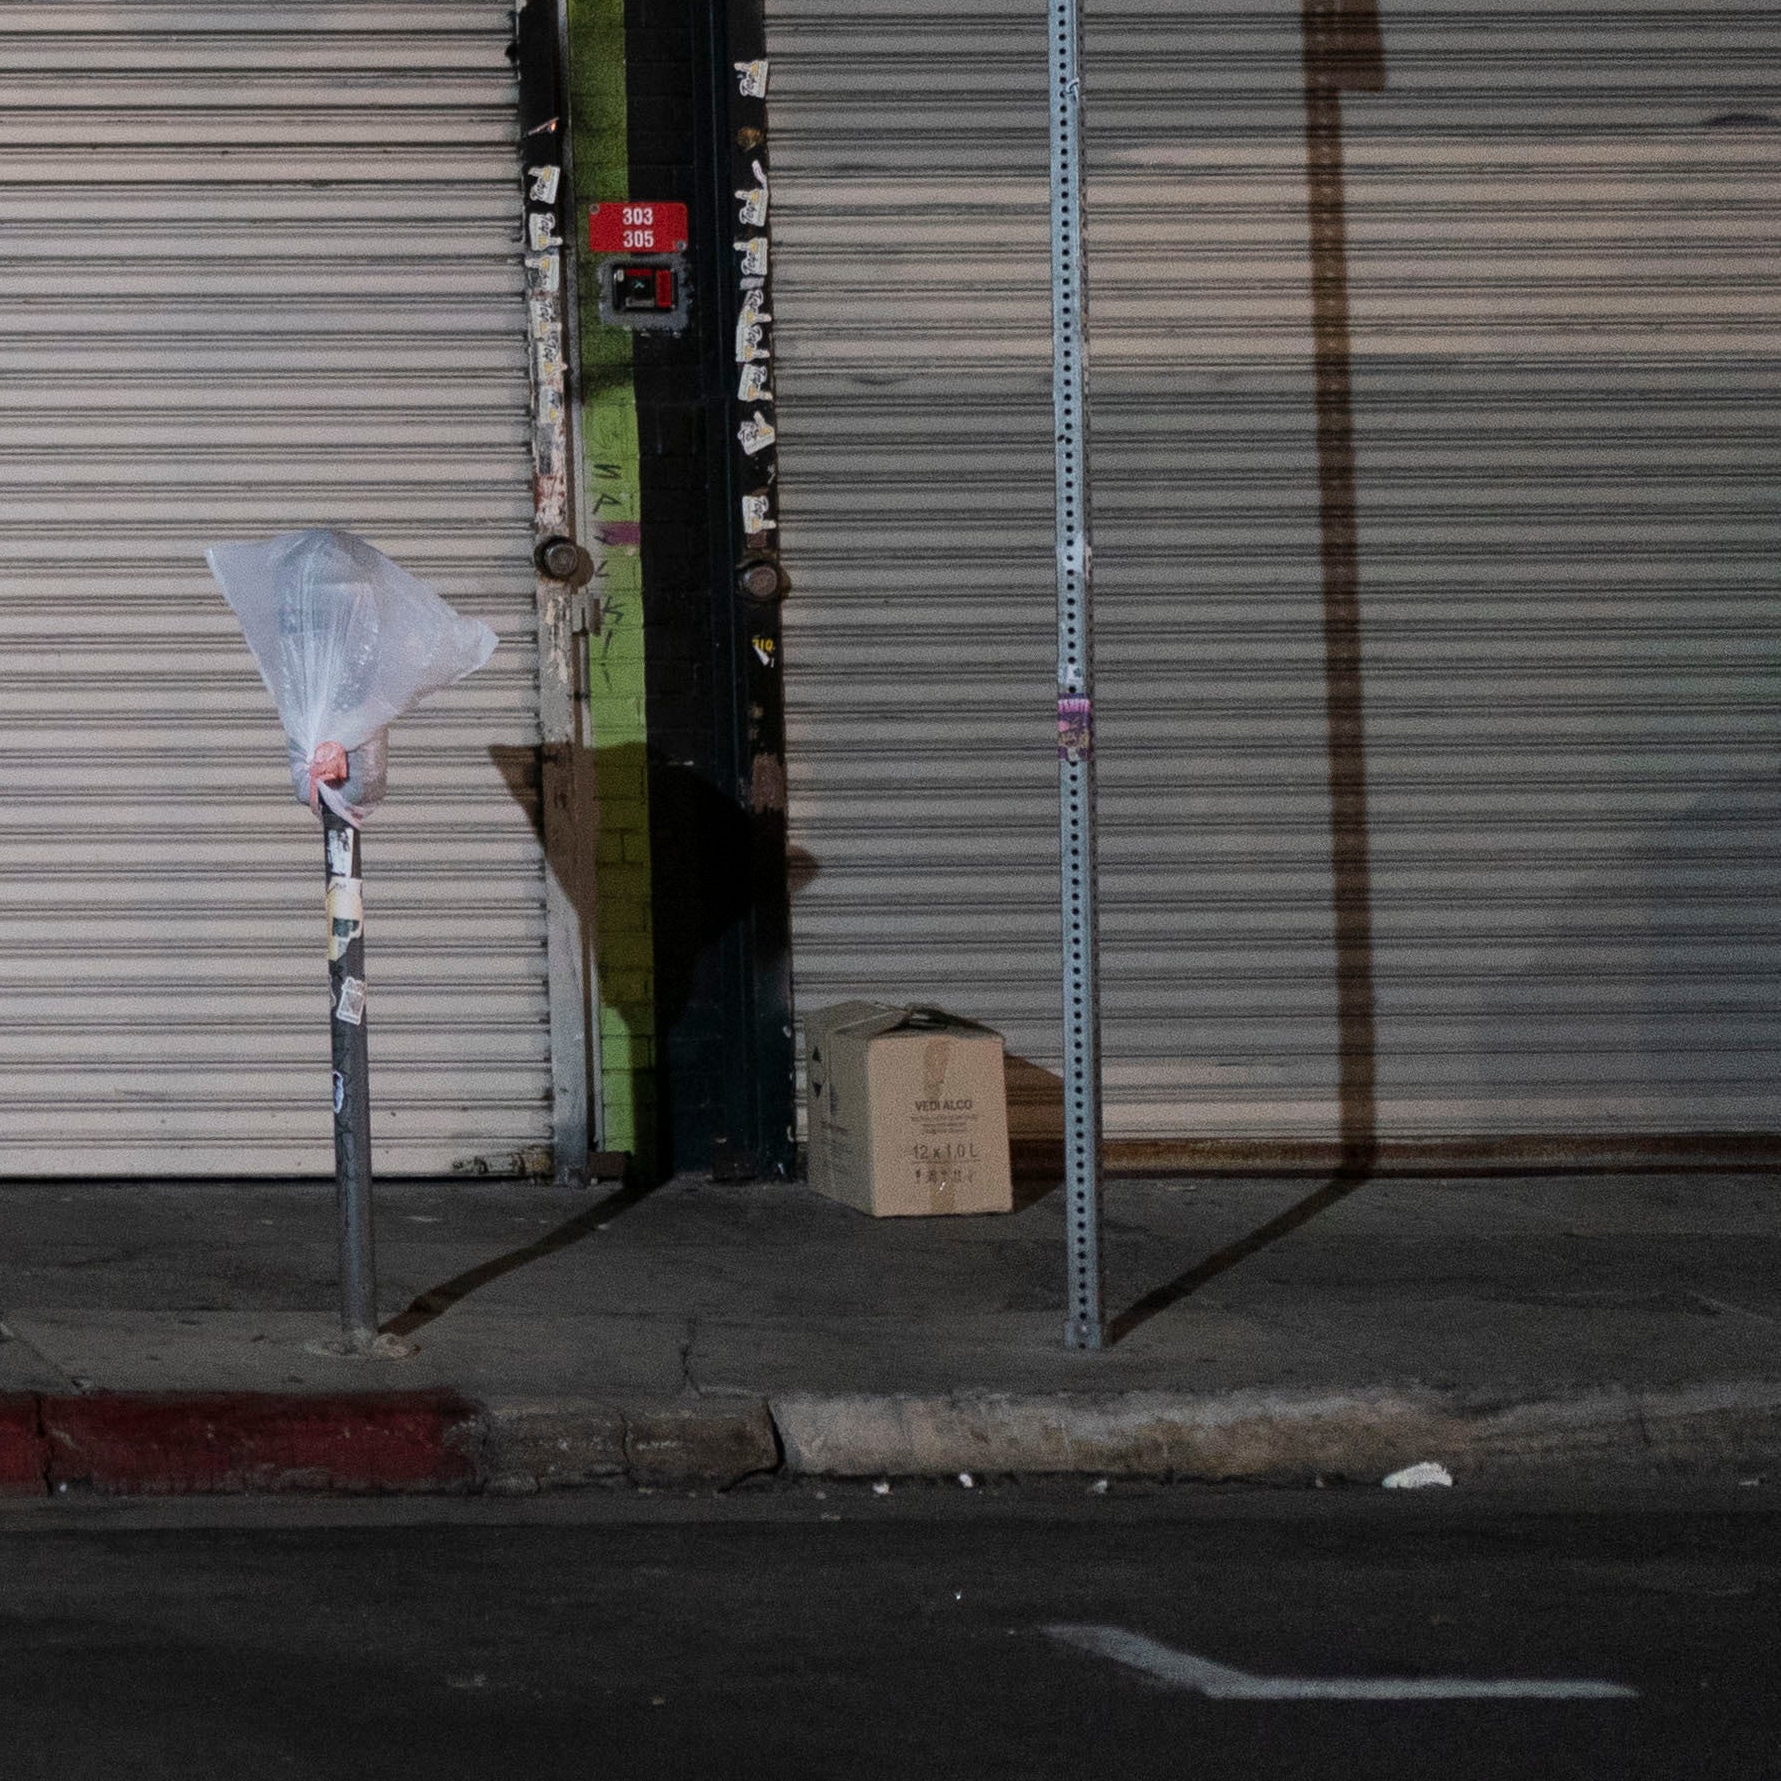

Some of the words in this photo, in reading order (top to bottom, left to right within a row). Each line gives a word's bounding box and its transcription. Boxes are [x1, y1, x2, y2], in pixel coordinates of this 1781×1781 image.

[622, 206, 654, 226] 303
[623, 229, 655, 249] 305
[913, 1143, 928, 1159] 12
